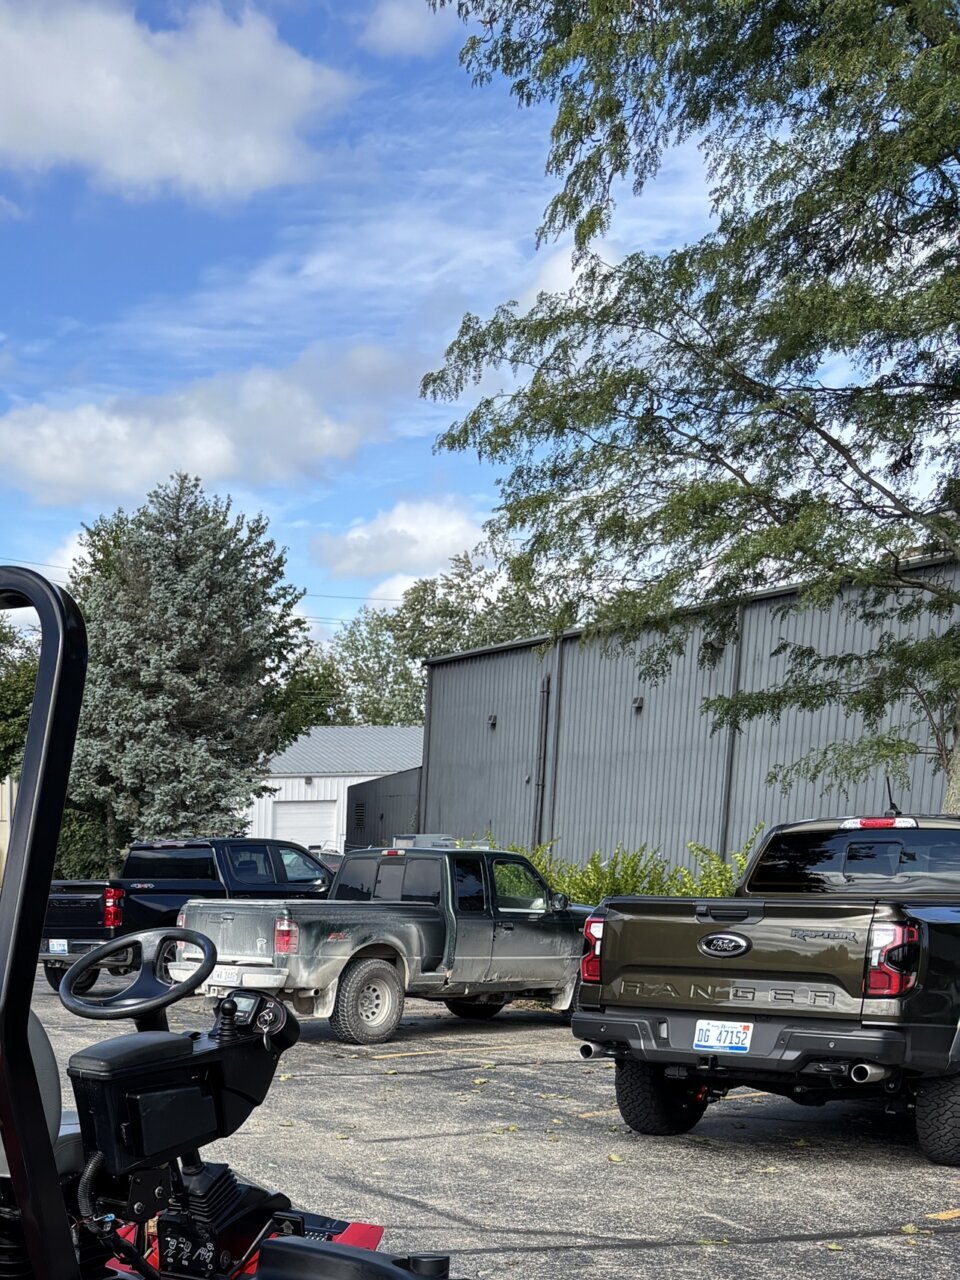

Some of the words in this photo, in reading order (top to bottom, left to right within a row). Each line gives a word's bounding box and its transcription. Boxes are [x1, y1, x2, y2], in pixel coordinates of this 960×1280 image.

[710, 937, 736, 951] Ford
[791, 928, 859, 944] RAPTOR
[620, 980, 836, 1006] RANGER
[697, 1028, 710, 1043] DG
[716, 1029, 748, 1046] 47152
